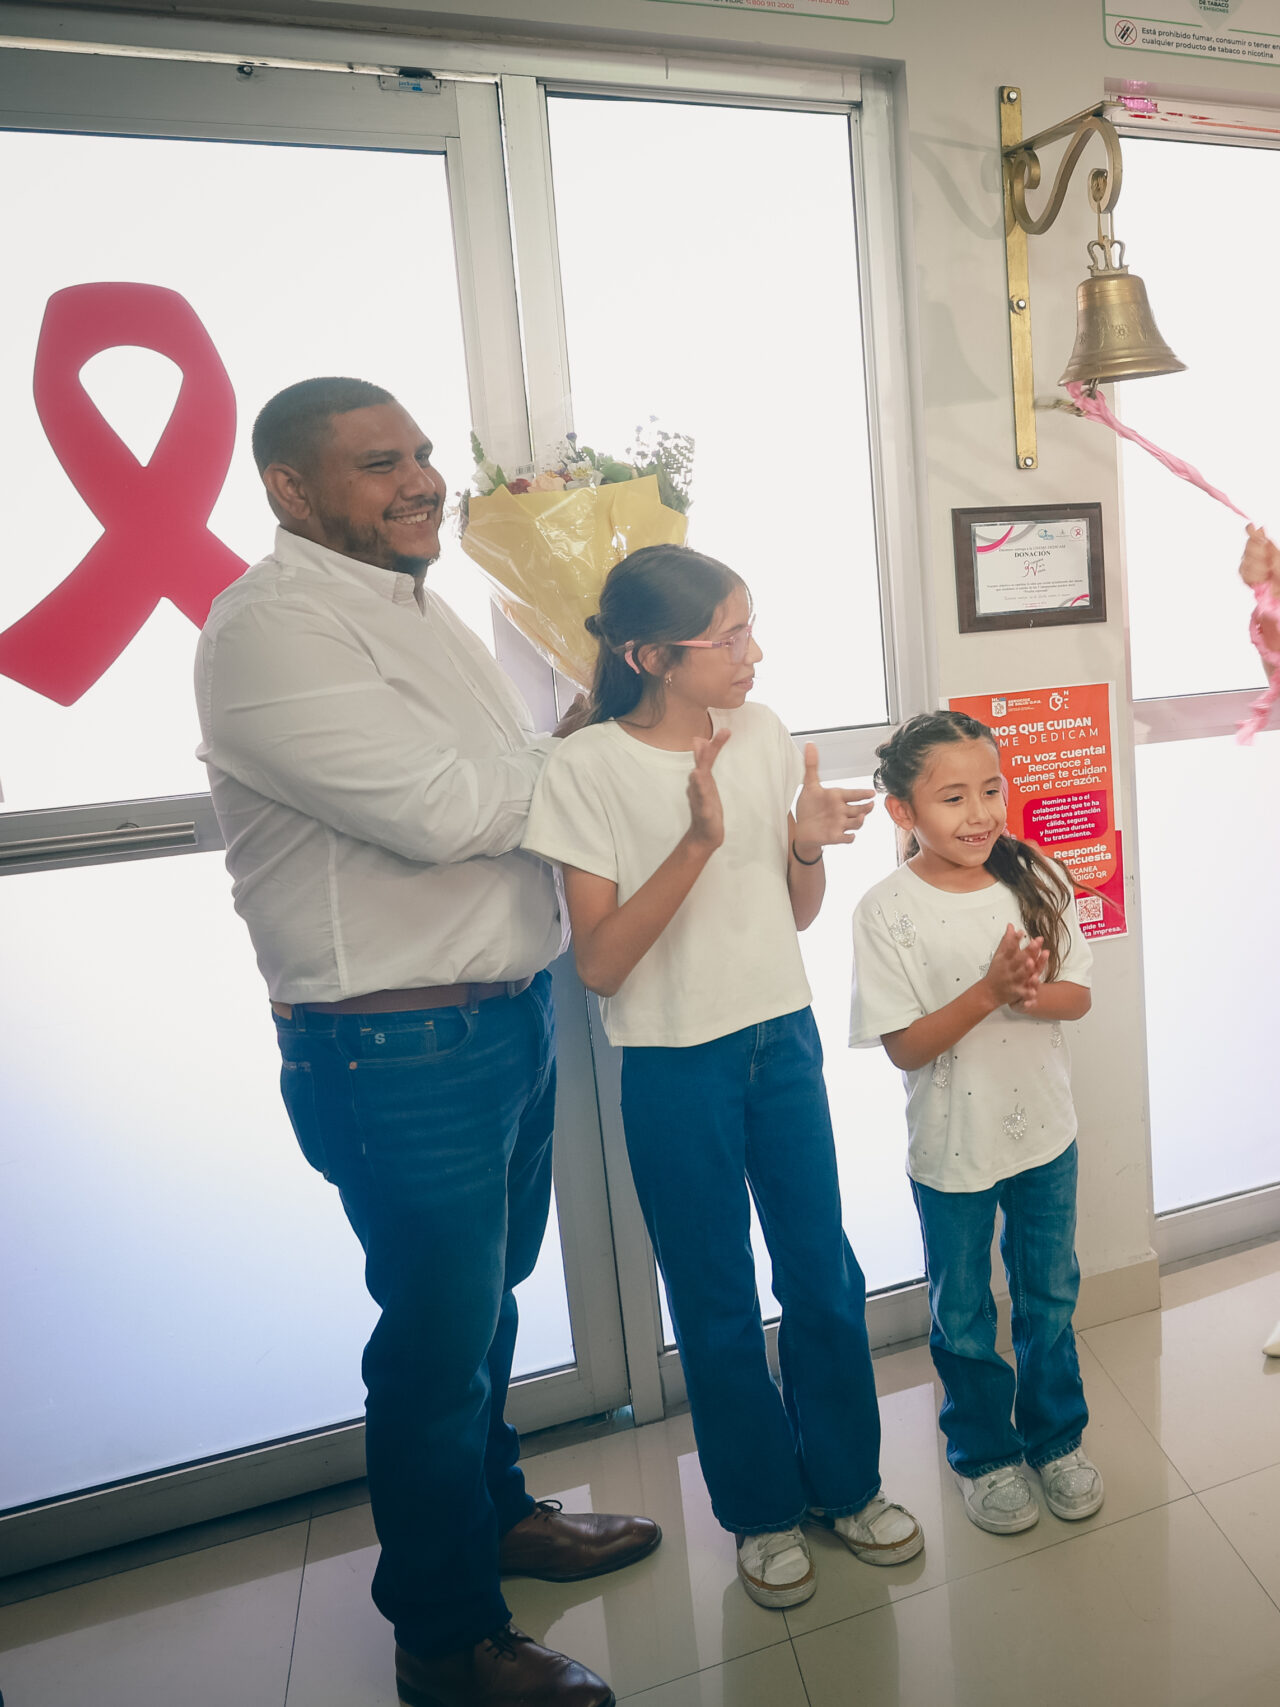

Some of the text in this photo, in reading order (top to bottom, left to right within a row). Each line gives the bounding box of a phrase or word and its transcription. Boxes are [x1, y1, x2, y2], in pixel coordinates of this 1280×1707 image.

[1207, 0, 1229, 8] TABACO
[1142, 27, 1156, 35] Está
[1158, 30, 1191, 39] prohibido
[1192, 34, 1214, 42] fumar,
[1216, 37, 1246, 46] consumir
[1254, 41, 1270, 49] tener
[1142, 38, 1174, 46] cualquier
[1176, 42, 1206, 50] producto
[1208, 44, 1216, 52] de
[1218, 46, 1240, 54] tabaco
[1248, 50, 1273, 58] nicotina
[1014, 550, 1051, 558] DONACIÓN
[1019, 722, 1044, 735] QUE
[1046, 716, 1092, 730] CUIDAN
[1000, 728, 1098, 748] ME DEDICAM
[1012, 745, 1106, 766] ¡Tu voz cuenta!
[1028, 759, 1081, 772] Reconoce
[1013, 765, 1107, 786] quienes te cuidan
[1020, 775, 1102, 793] con el corazón.
[1042, 798, 1066, 806] Nomina
[1032, 812, 1060, 822] brindado
[1074, 807, 1100, 816] atención
[1033, 804, 1070, 814] colaborador
[1046, 817, 1088, 828] cálida, segura
[1045, 826, 1070, 835] humana
[1071, 823, 1095, 831] durante
[1052, 831, 1092, 841] tratamiento.
[1054, 844, 1107, 859] Responde
[1063, 852, 1112, 866] encuesta
[1096, 870, 1106, 878] QR
[1082, 922, 1096, 931] pide
[1093, 926, 1122, 936] impresa.
[374, 1033, 386, 1044] S
